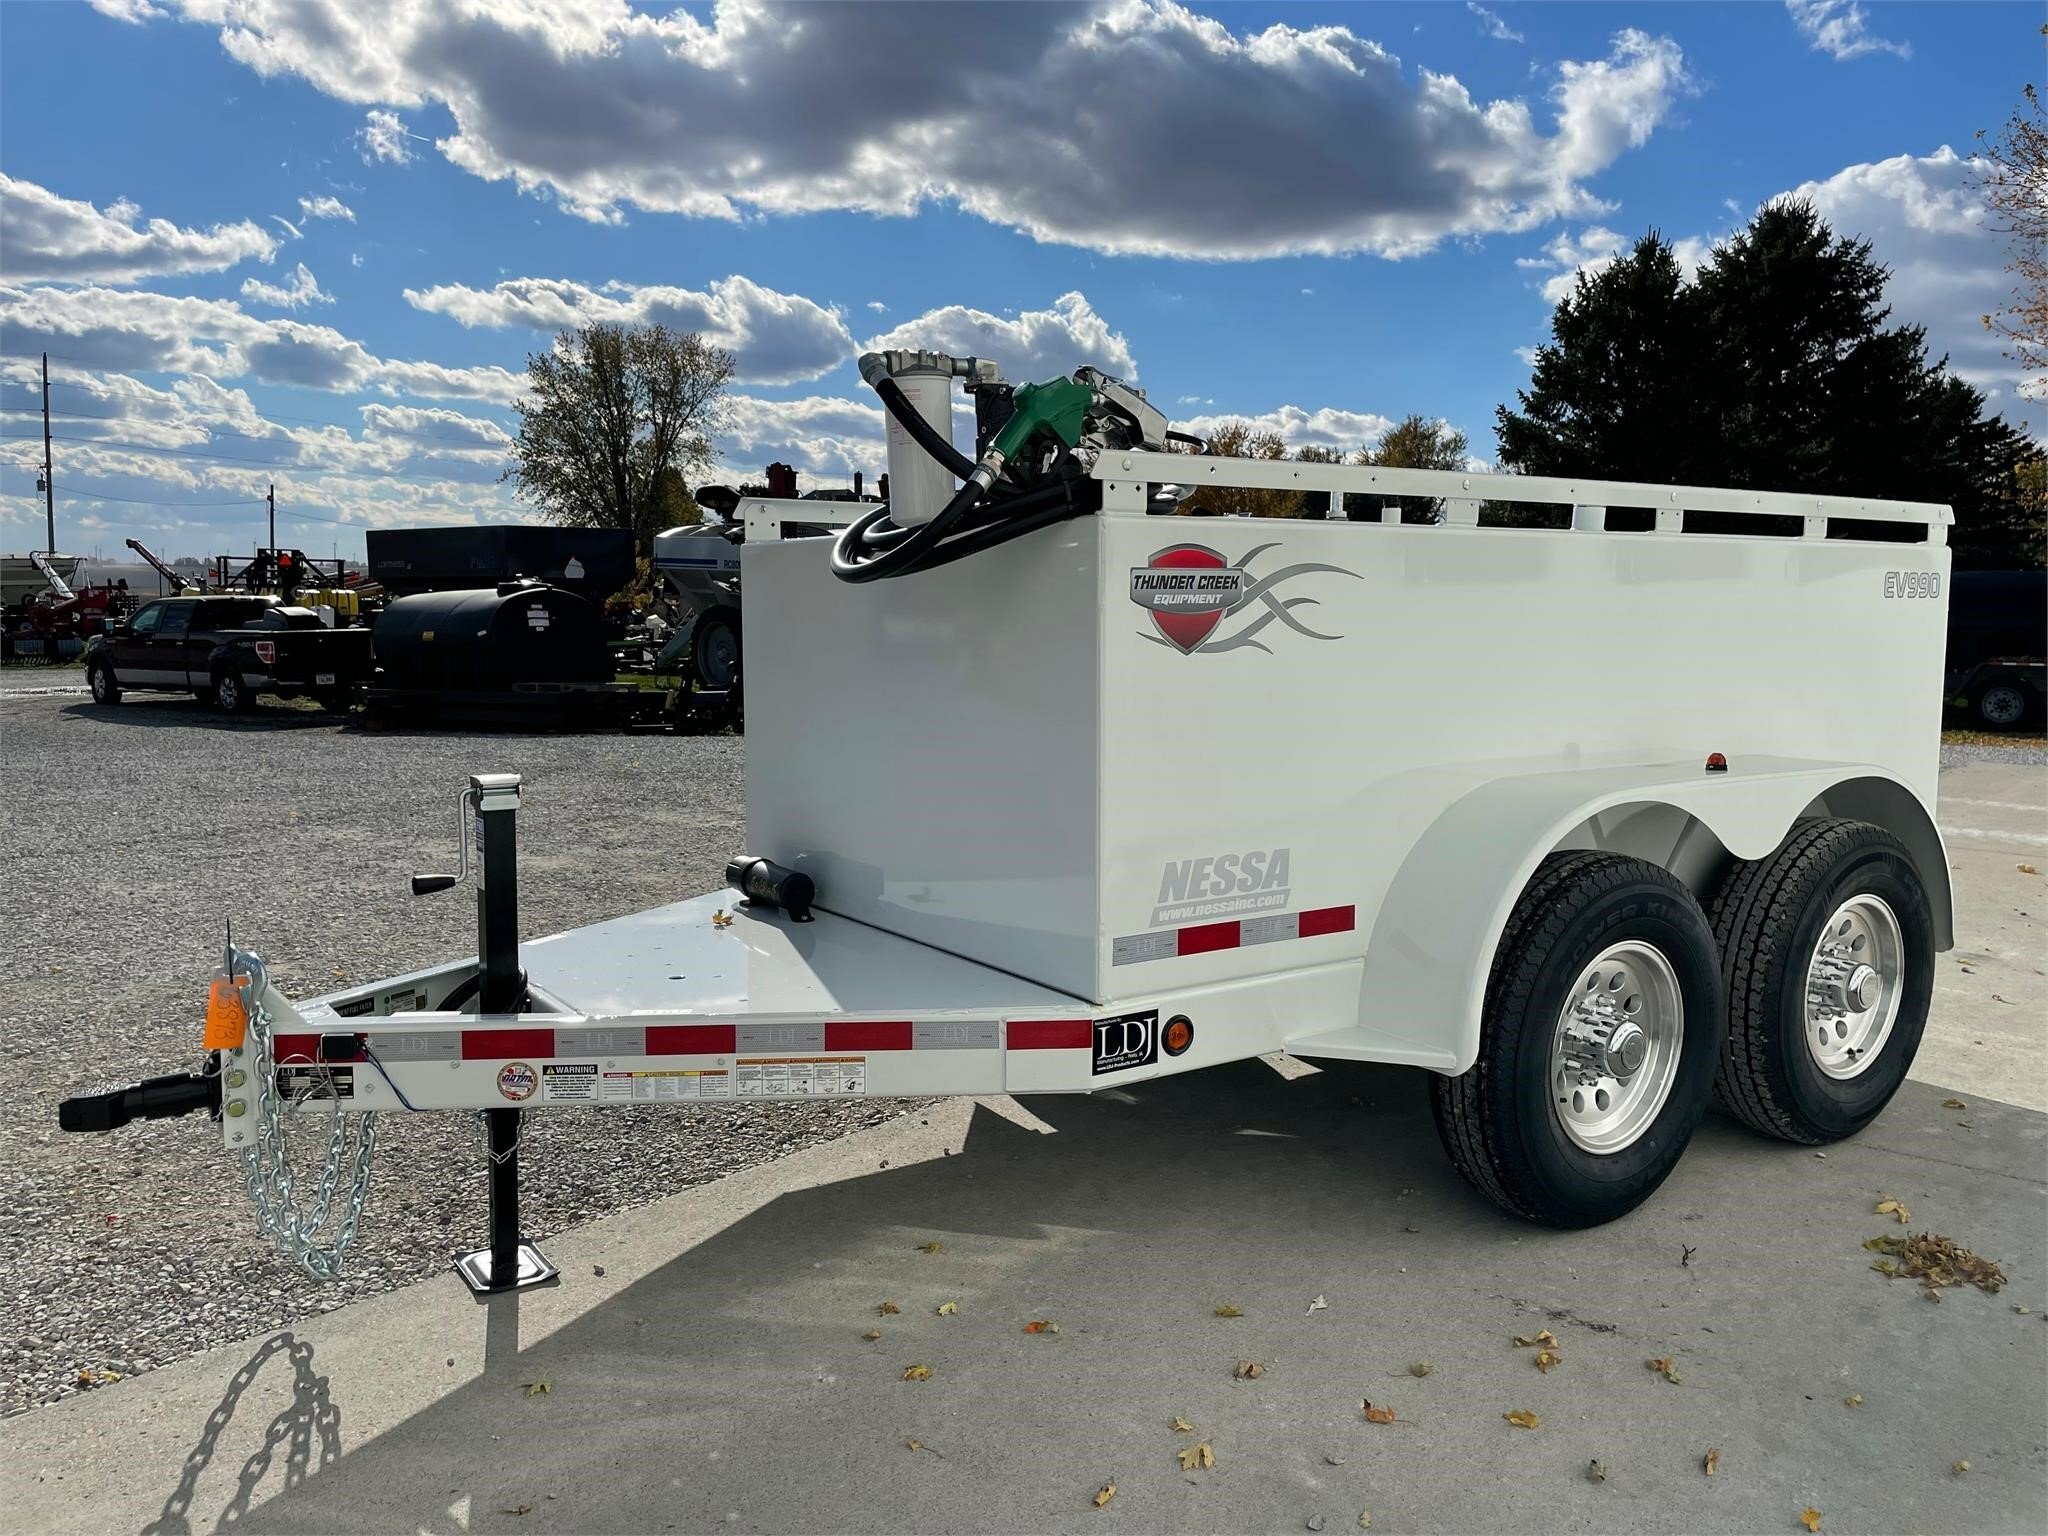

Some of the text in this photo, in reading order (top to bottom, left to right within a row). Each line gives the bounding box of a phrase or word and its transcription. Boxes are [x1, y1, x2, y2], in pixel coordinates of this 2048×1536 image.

[1134, 575, 1240, 590] THUNDER CREEK
[1884, 571, 1941, 598] EV990
[1153, 594, 1223, 605] EQUIPMENT
[1157, 848, 1290, 904] NESSA
[1159, 894, 1285, 921] www.nessainc.com
[1097, 1017, 1157, 1062] LDJ
[555, 1065, 595, 1074] WARNING
